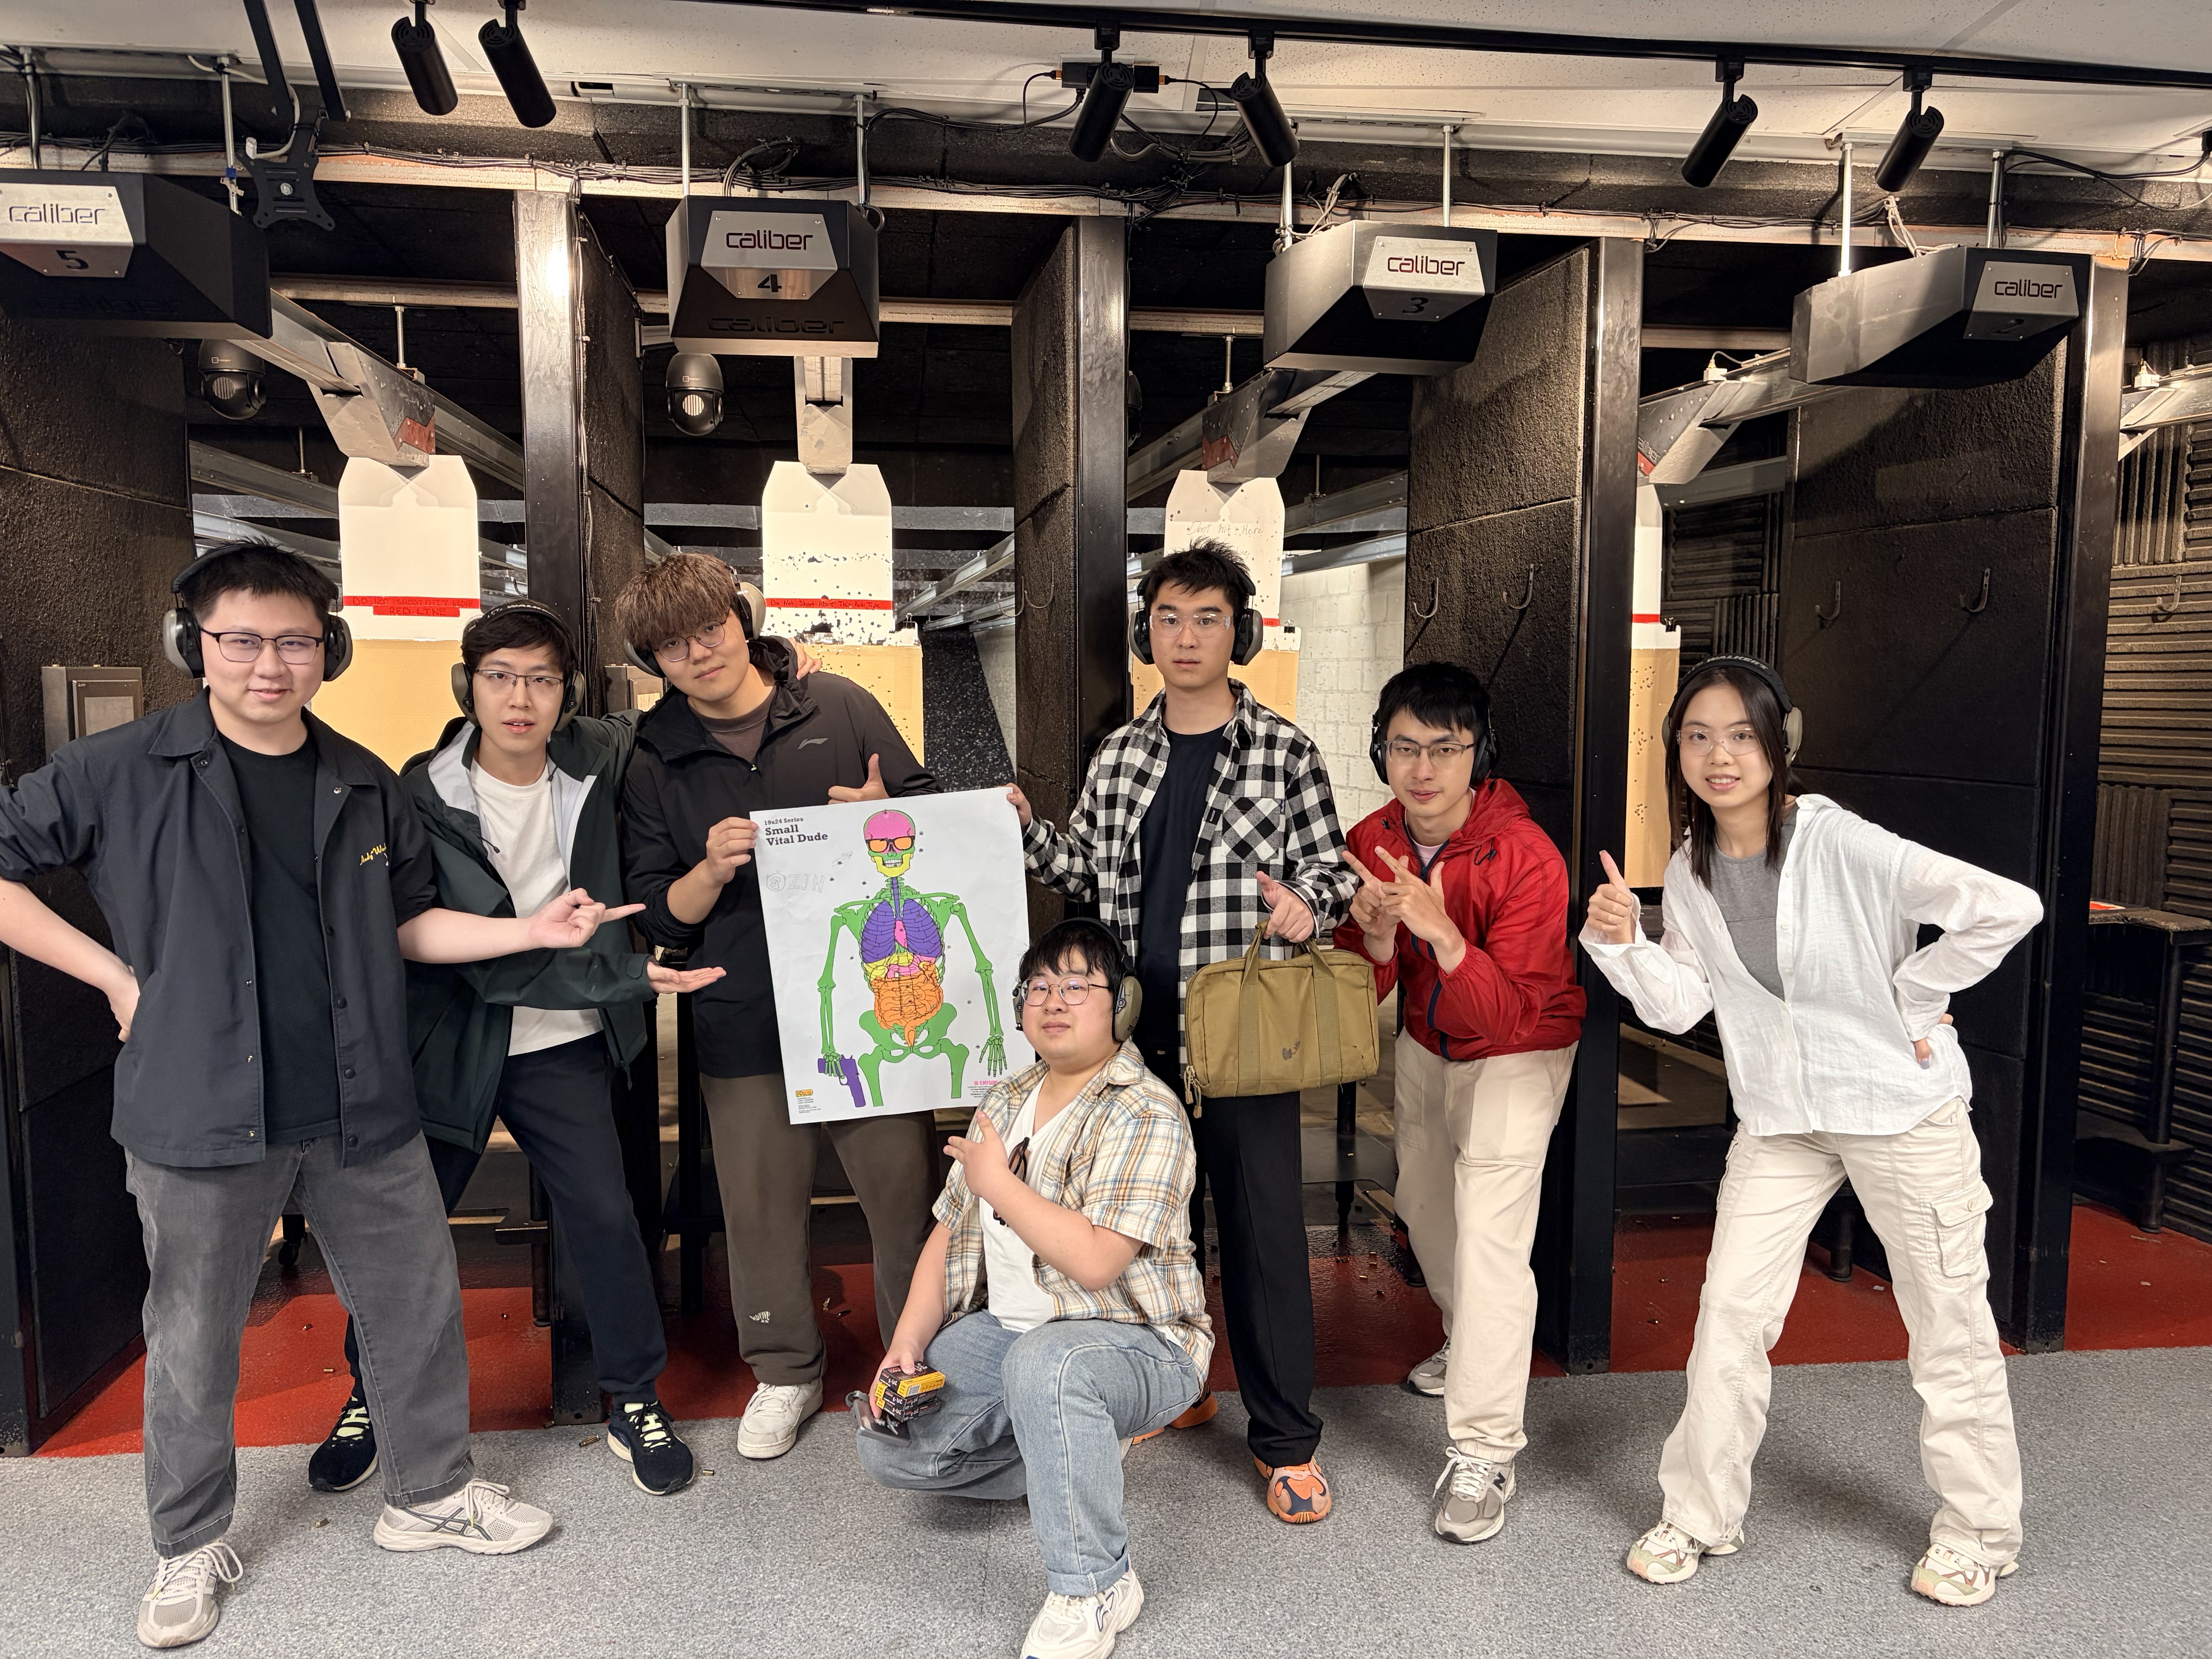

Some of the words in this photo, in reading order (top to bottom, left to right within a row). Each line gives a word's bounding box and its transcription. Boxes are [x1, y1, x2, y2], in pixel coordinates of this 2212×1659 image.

[9, 204, 105, 225] caliber
[726, 230, 813, 251] caliber
[55, 250, 89, 270] 5
[1387, 255, 1465, 276] caliber
[757, 274, 782, 293] 4
[1994, 278, 2063, 299] caliber
[1402, 297, 1429, 315] 3
[708, 315, 845, 334] caliber
[1992, 318, 2025, 334] 2
[1218, 524, 1231, 534] hit
[1242, 524, 1264, 535] Here
[353, 597, 368, 605] DO
[390, 607, 410, 615] RED
[765, 824, 799, 836] Small
[766, 835, 795, 846] Vital
[797, 832, 828, 843] Dude
[787, 874, 825, 893] ZJH
